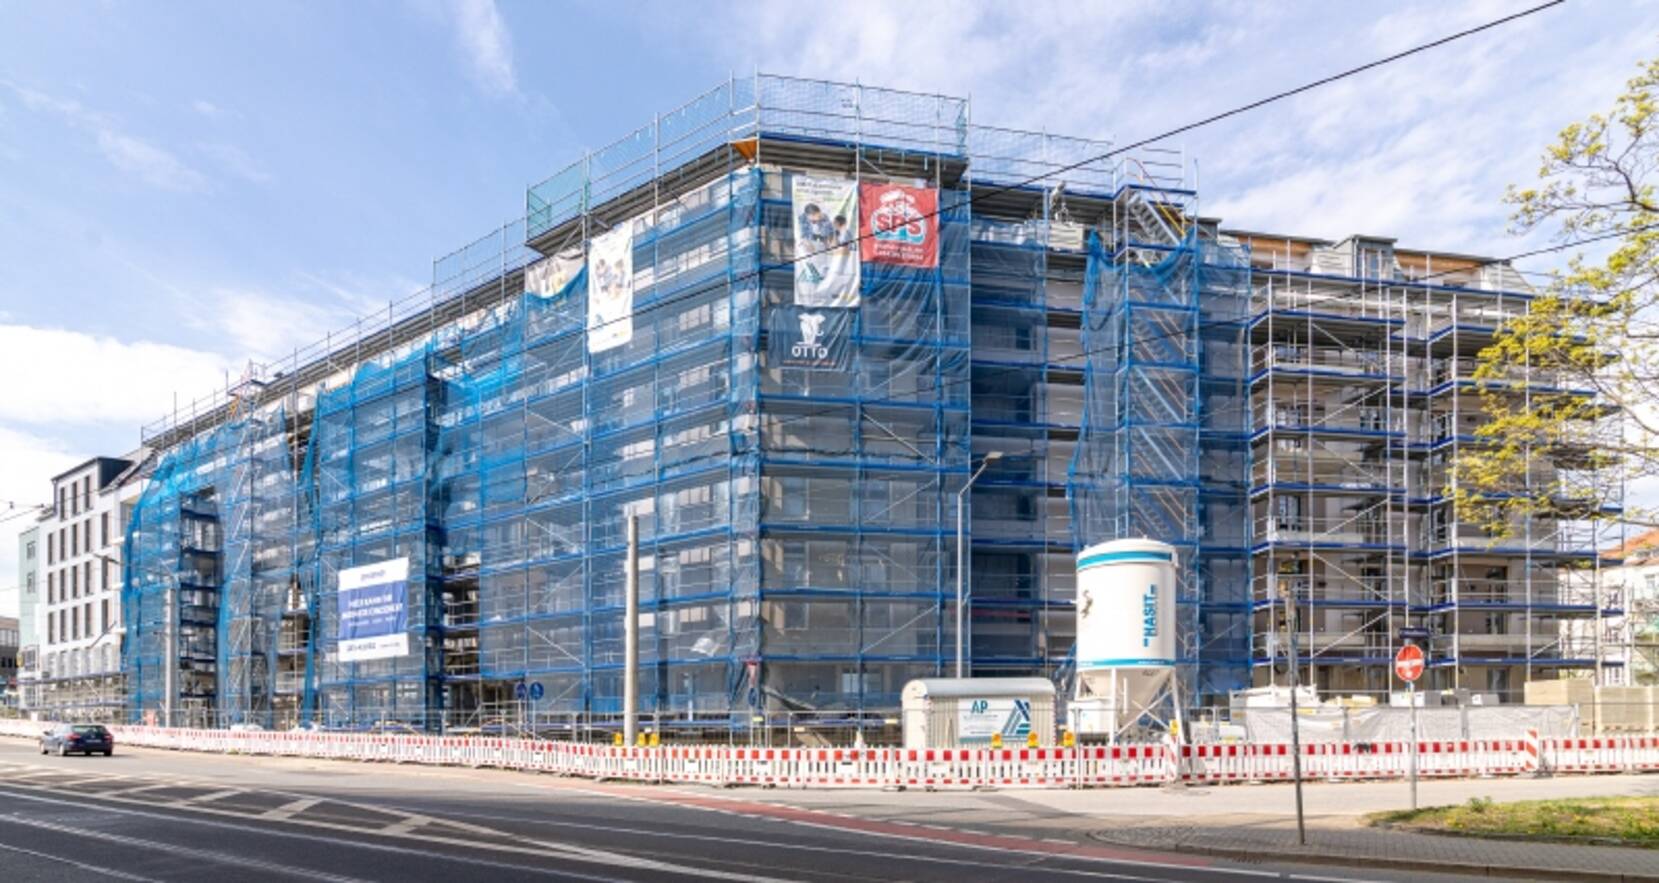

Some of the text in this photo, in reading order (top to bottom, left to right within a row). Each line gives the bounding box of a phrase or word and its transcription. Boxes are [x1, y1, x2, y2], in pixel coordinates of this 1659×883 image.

[876, 213, 921, 235] SPS
[791, 344, 828, 359] OTTO
[1143, 593, 1158, 637] HASIT
[971, 699, 988, 714] AP
